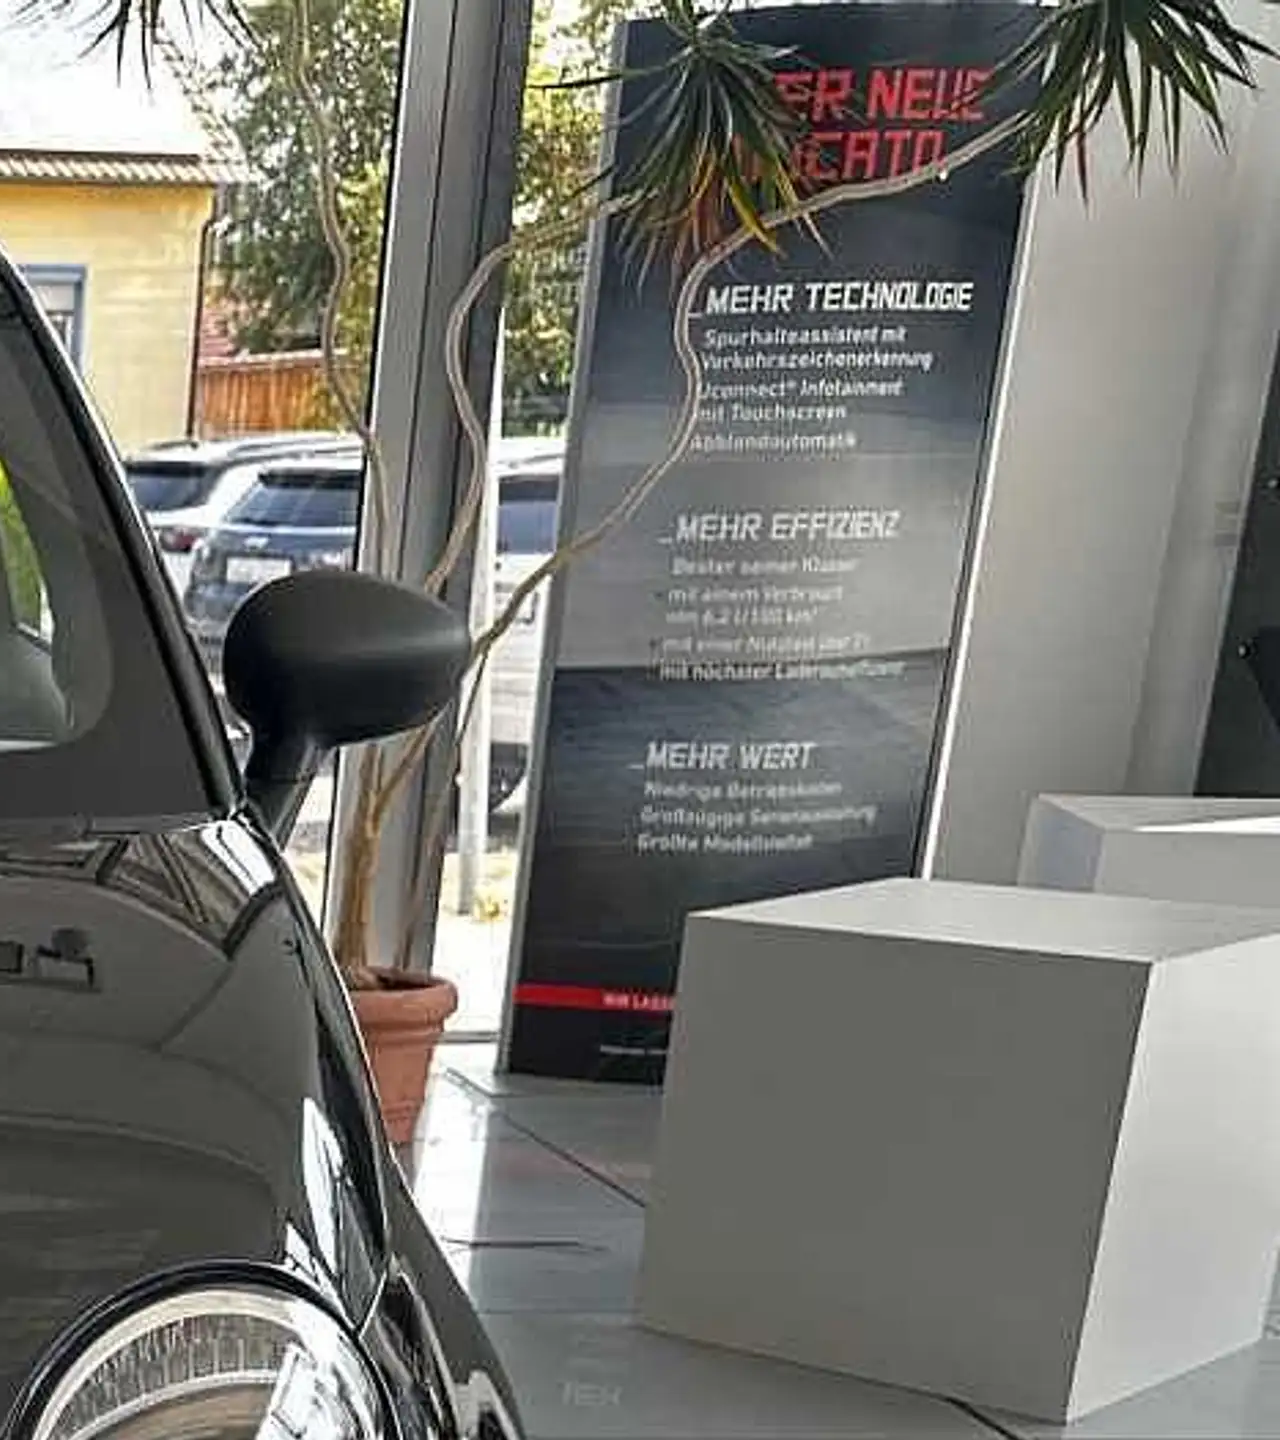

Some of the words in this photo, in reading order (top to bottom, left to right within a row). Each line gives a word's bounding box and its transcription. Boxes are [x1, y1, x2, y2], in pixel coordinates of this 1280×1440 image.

[804, 281, 975, 312] TECHNOLOGIE
[771, 509, 902, 541] EFFIZIENZ
[739, 740, 818, 770] WERT
